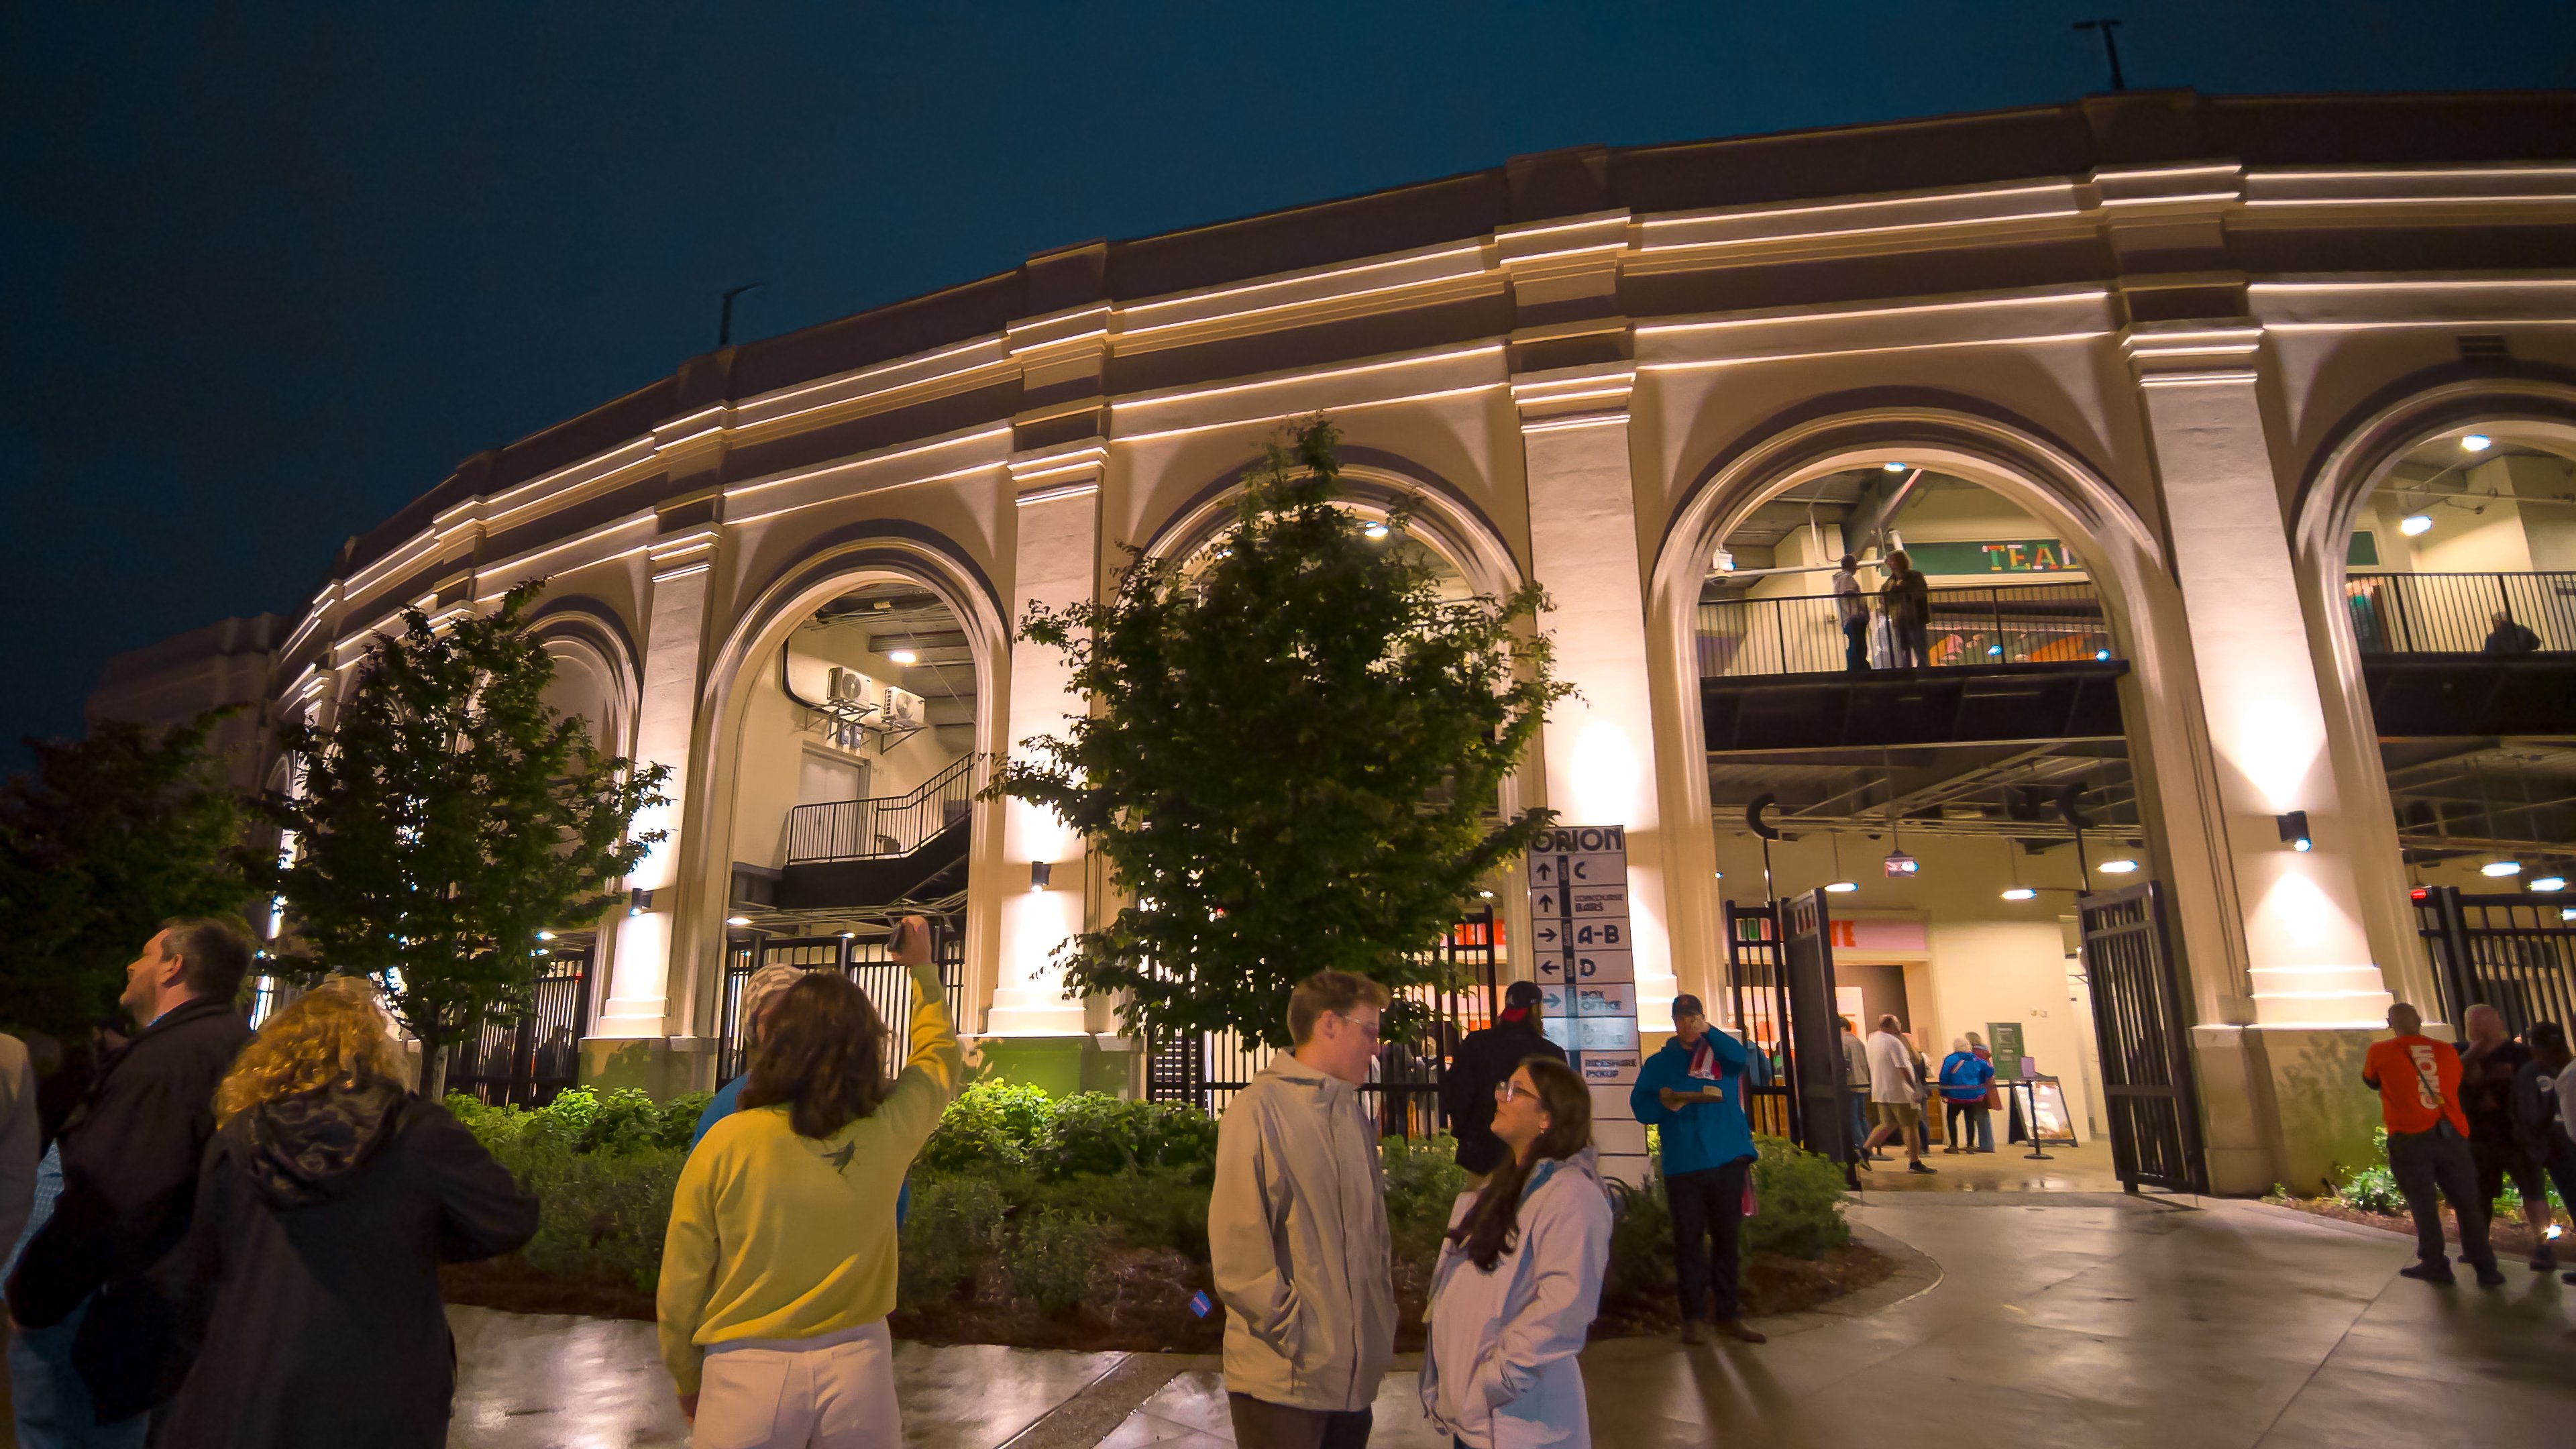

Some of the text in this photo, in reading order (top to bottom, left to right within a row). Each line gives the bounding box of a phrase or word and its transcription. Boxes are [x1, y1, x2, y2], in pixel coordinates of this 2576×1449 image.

[1530, 828, 1622, 853] ORION
[1574, 861, 1587, 879] C
[1578, 924, 1619, 945] A-B
[1579, 958, 1596, 977] D
